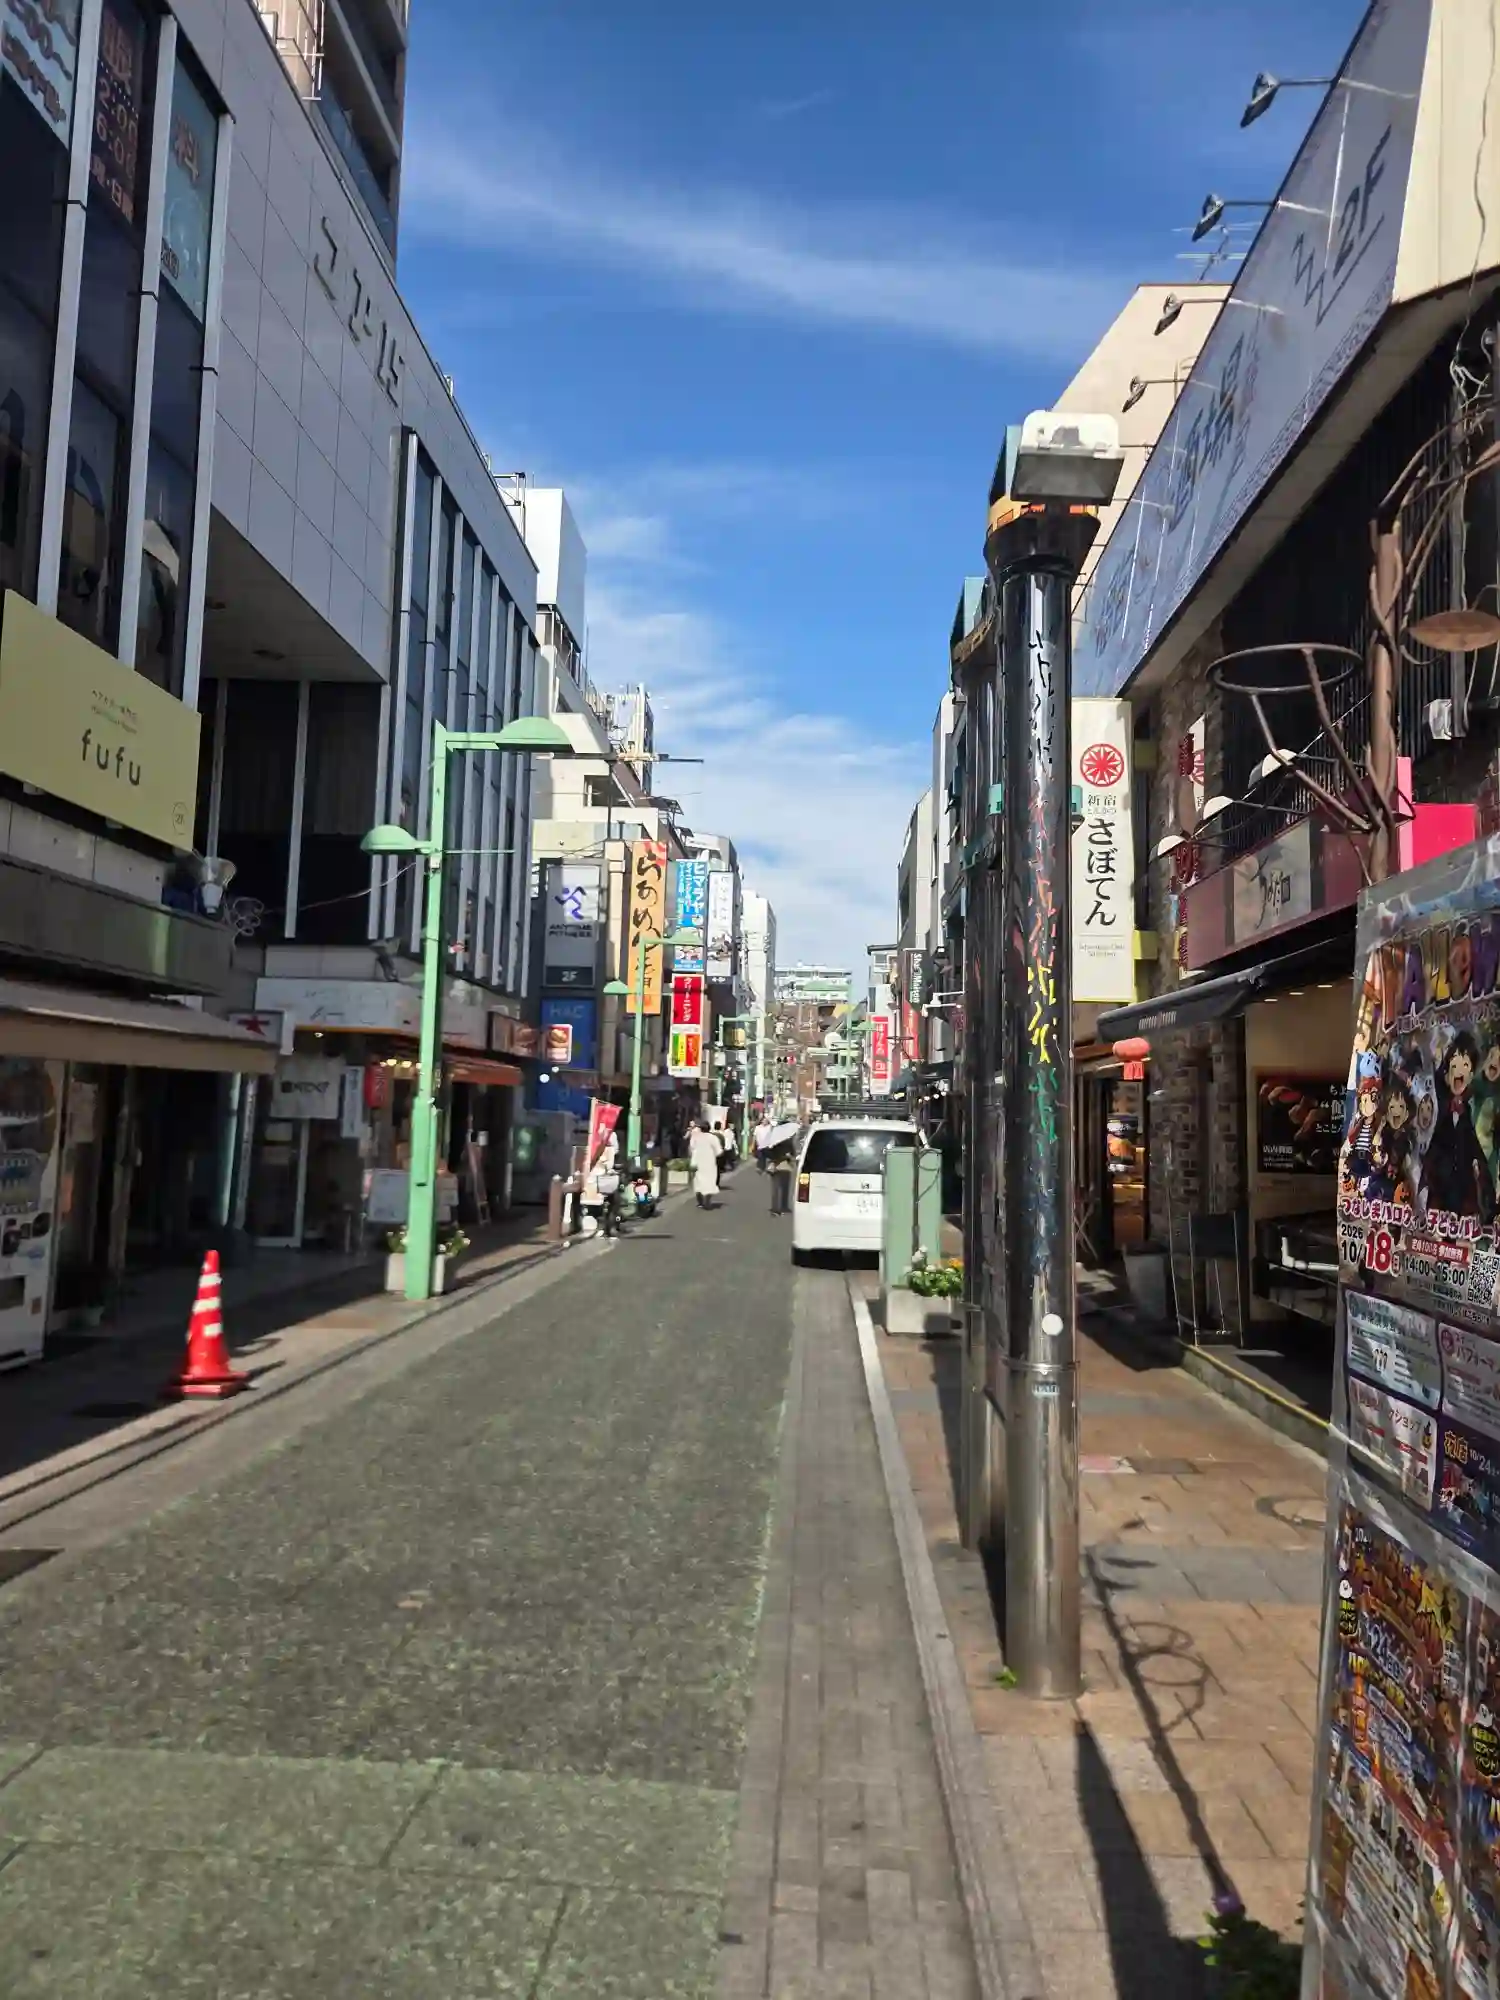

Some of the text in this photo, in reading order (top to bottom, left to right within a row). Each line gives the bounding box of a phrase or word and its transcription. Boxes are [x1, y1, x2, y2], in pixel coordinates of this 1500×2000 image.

[82, 728, 141, 786] fufu
[1085, 818, 1118, 927] さぼてん
[682, 977, 693, 1022] クリーニング
